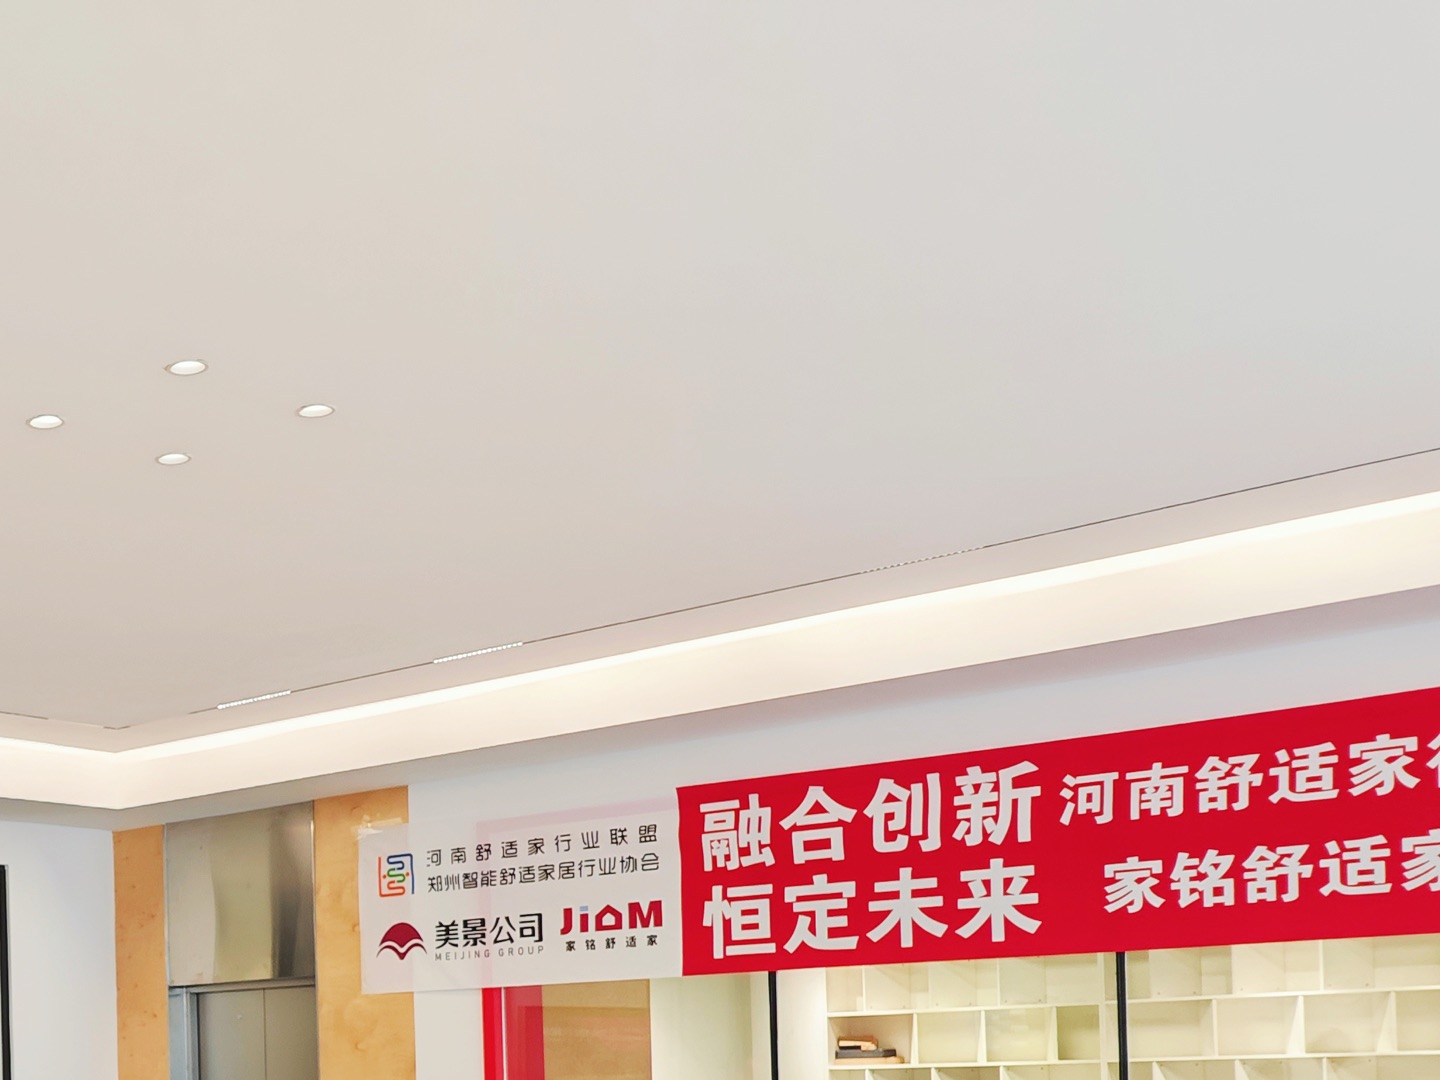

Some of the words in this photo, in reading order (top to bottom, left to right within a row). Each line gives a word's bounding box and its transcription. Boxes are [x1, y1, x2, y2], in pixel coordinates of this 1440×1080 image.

[699, 760, 1042, 872] 融合创新
[1059, 733, 1440, 827] 河南舒适家
[427, 823, 658, 867] 河南舒适家行业联盟
[427, 852, 660, 893] 郑州智能舒适家居行业协会
[702, 858, 1043, 960] 恒定未来
[435, 912, 544, 949] 美景公司
[565, 934, 659, 952] 家铭舒适家
[435, 949, 491, 961] MEIJING
[498, 945, 545, 957] GROUP
